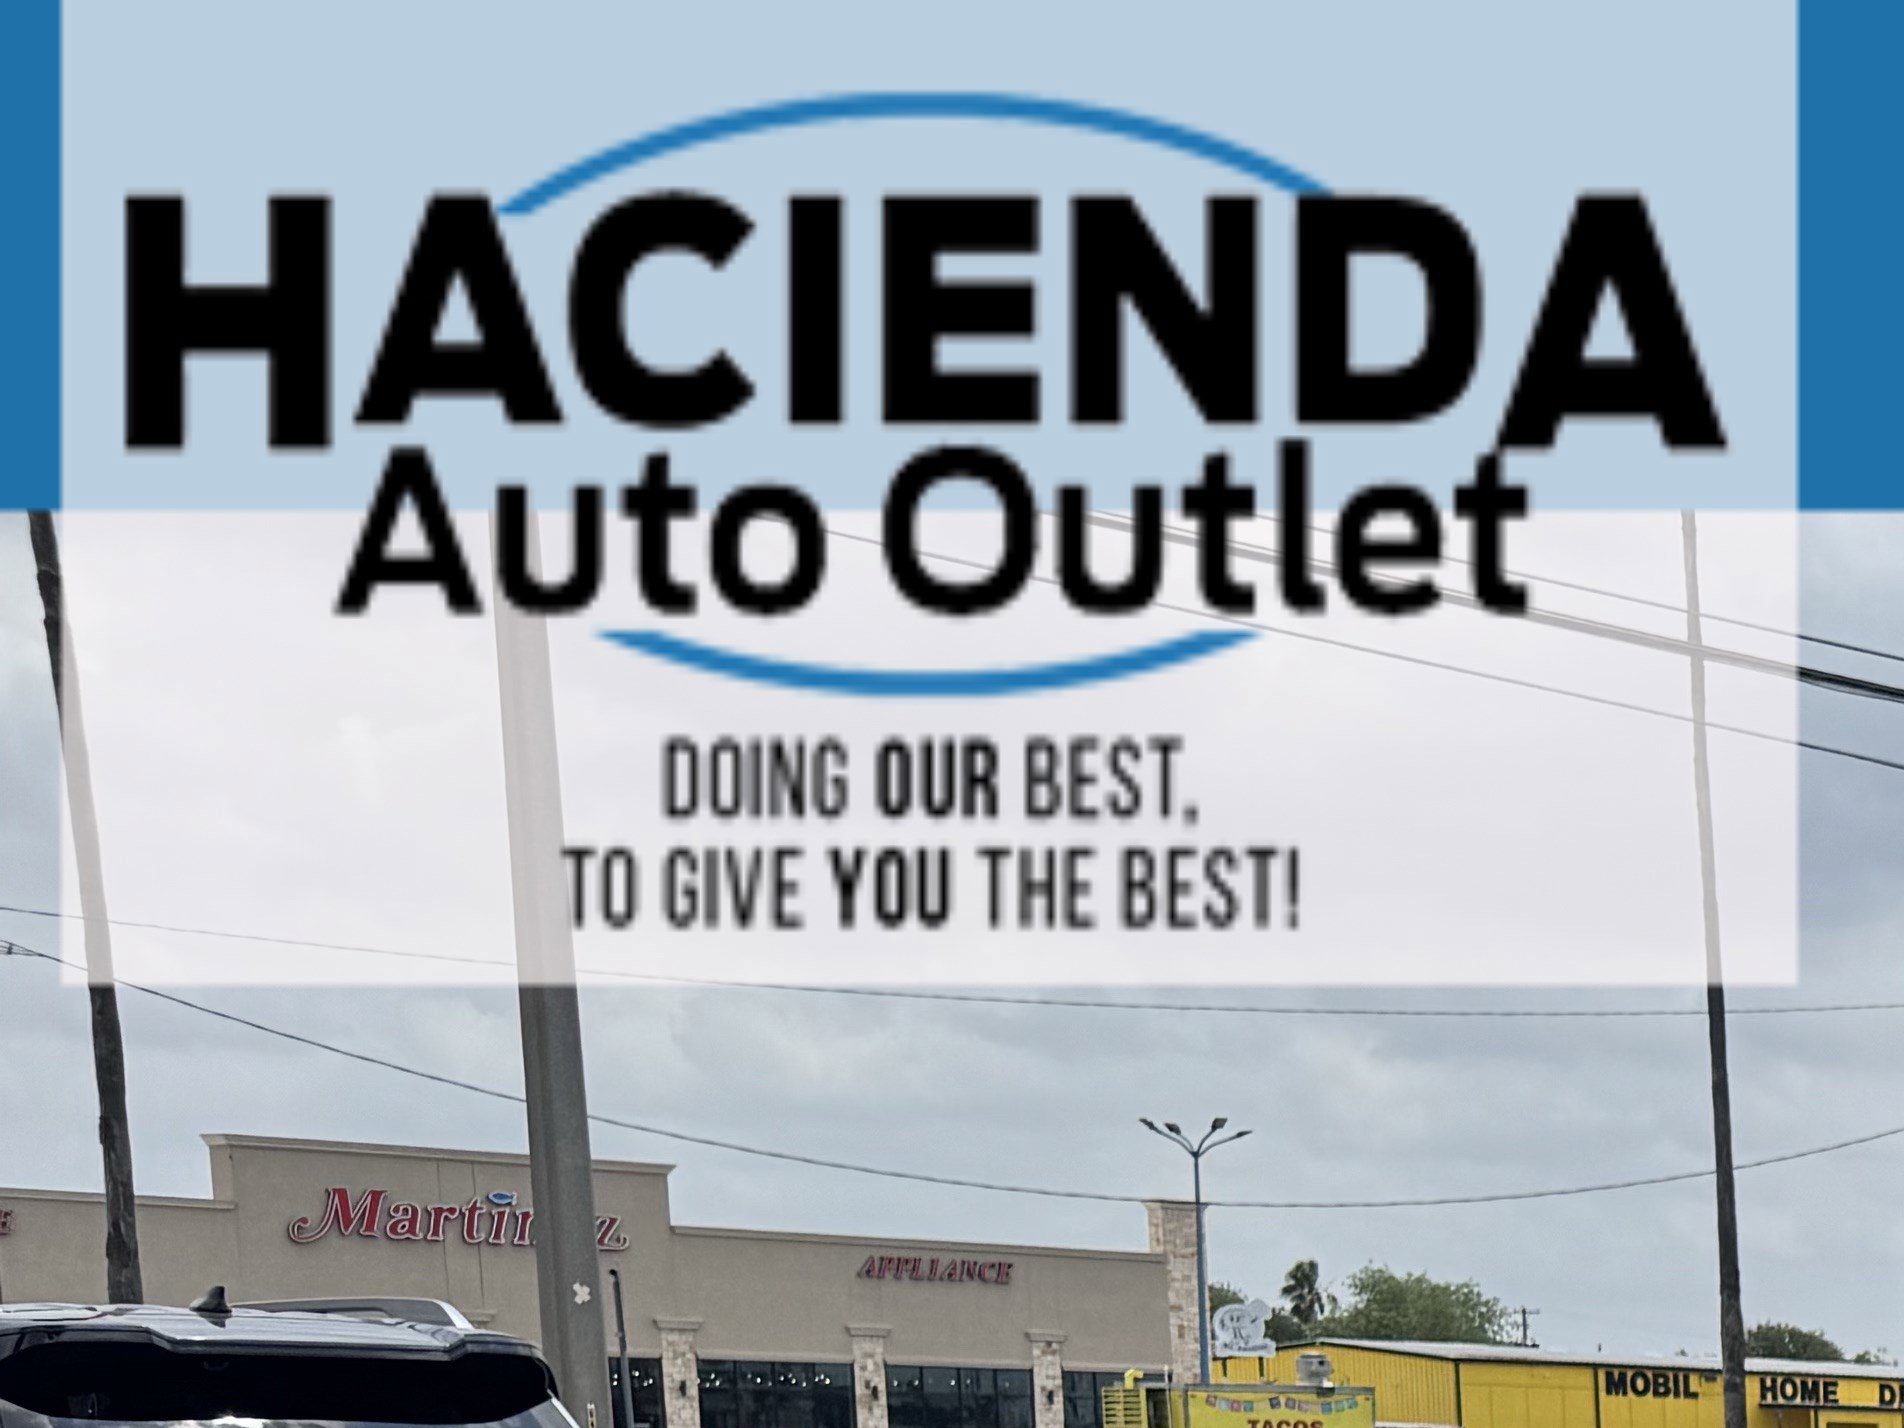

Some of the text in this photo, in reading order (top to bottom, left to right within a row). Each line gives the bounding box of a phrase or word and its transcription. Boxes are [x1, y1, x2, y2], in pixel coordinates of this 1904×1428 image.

[288, 1187, 630, 1251] Martiz
[857, 1255, 1015, 1285] APPLIANCE
[1604, 1369, 1700, 1399] MOBIL
[1759, 1377, 1840, 1405] HOME
